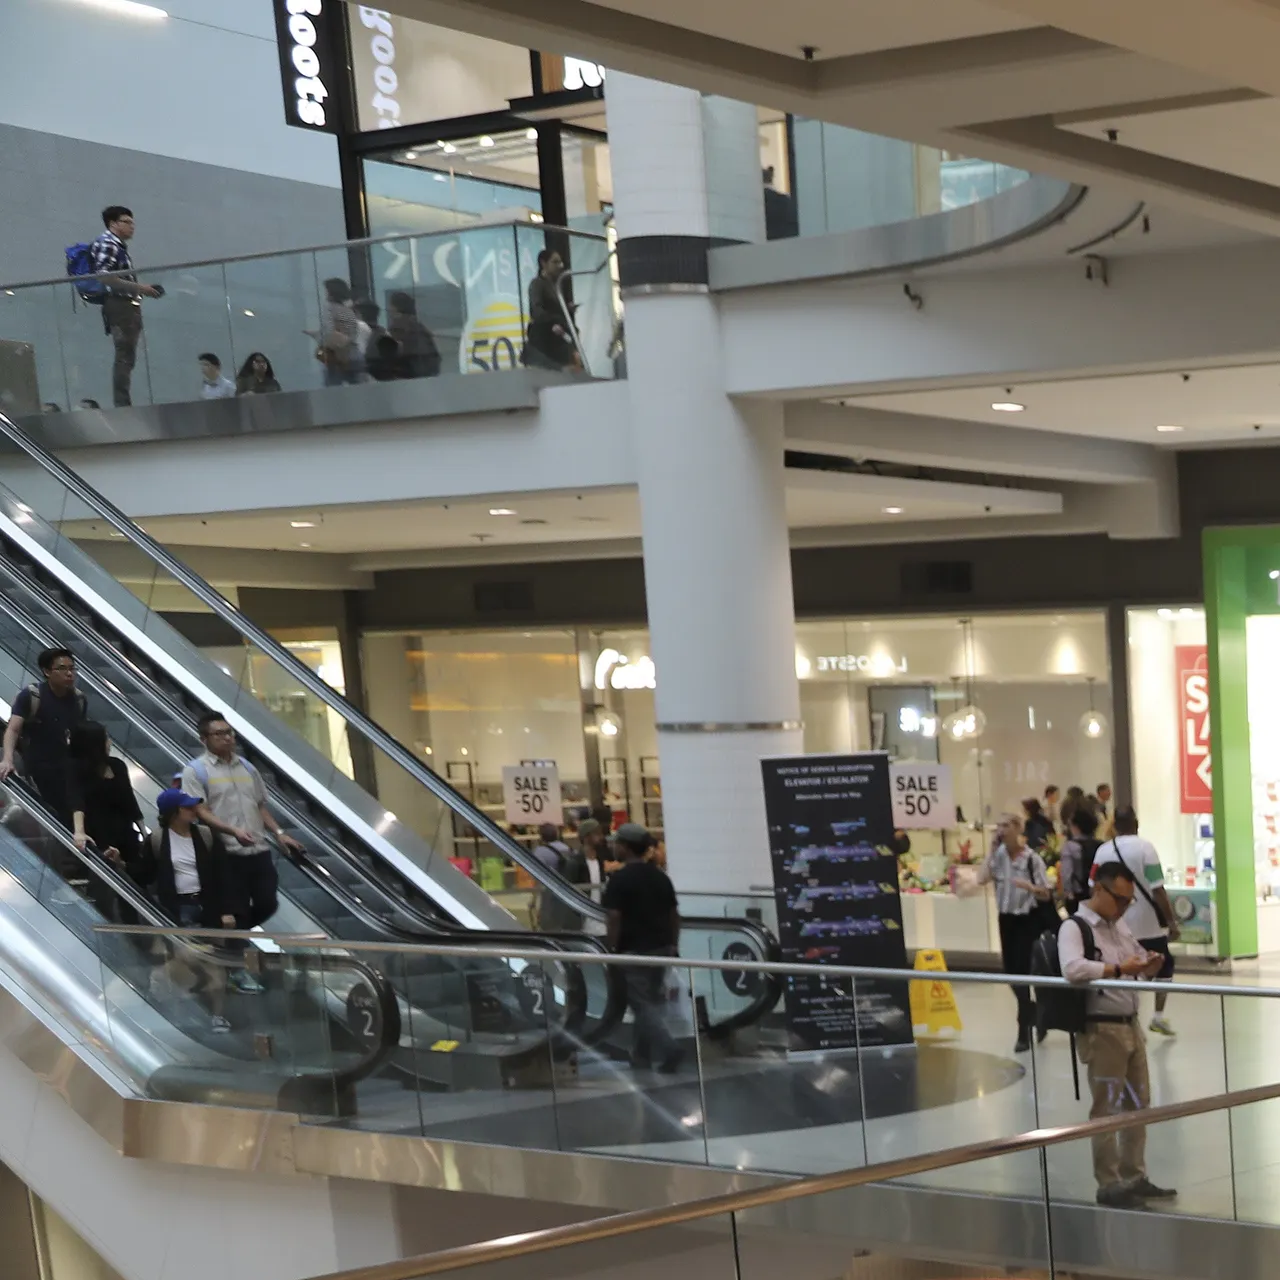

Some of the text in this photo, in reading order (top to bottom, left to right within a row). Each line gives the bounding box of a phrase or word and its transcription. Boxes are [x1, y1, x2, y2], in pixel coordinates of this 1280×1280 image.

[514, 776, 548, 791] SALE
[896, 775, 938, 791] SALE
[531, 989, 544, 1015] 2
[361, 1010, 375, 1037] 2
